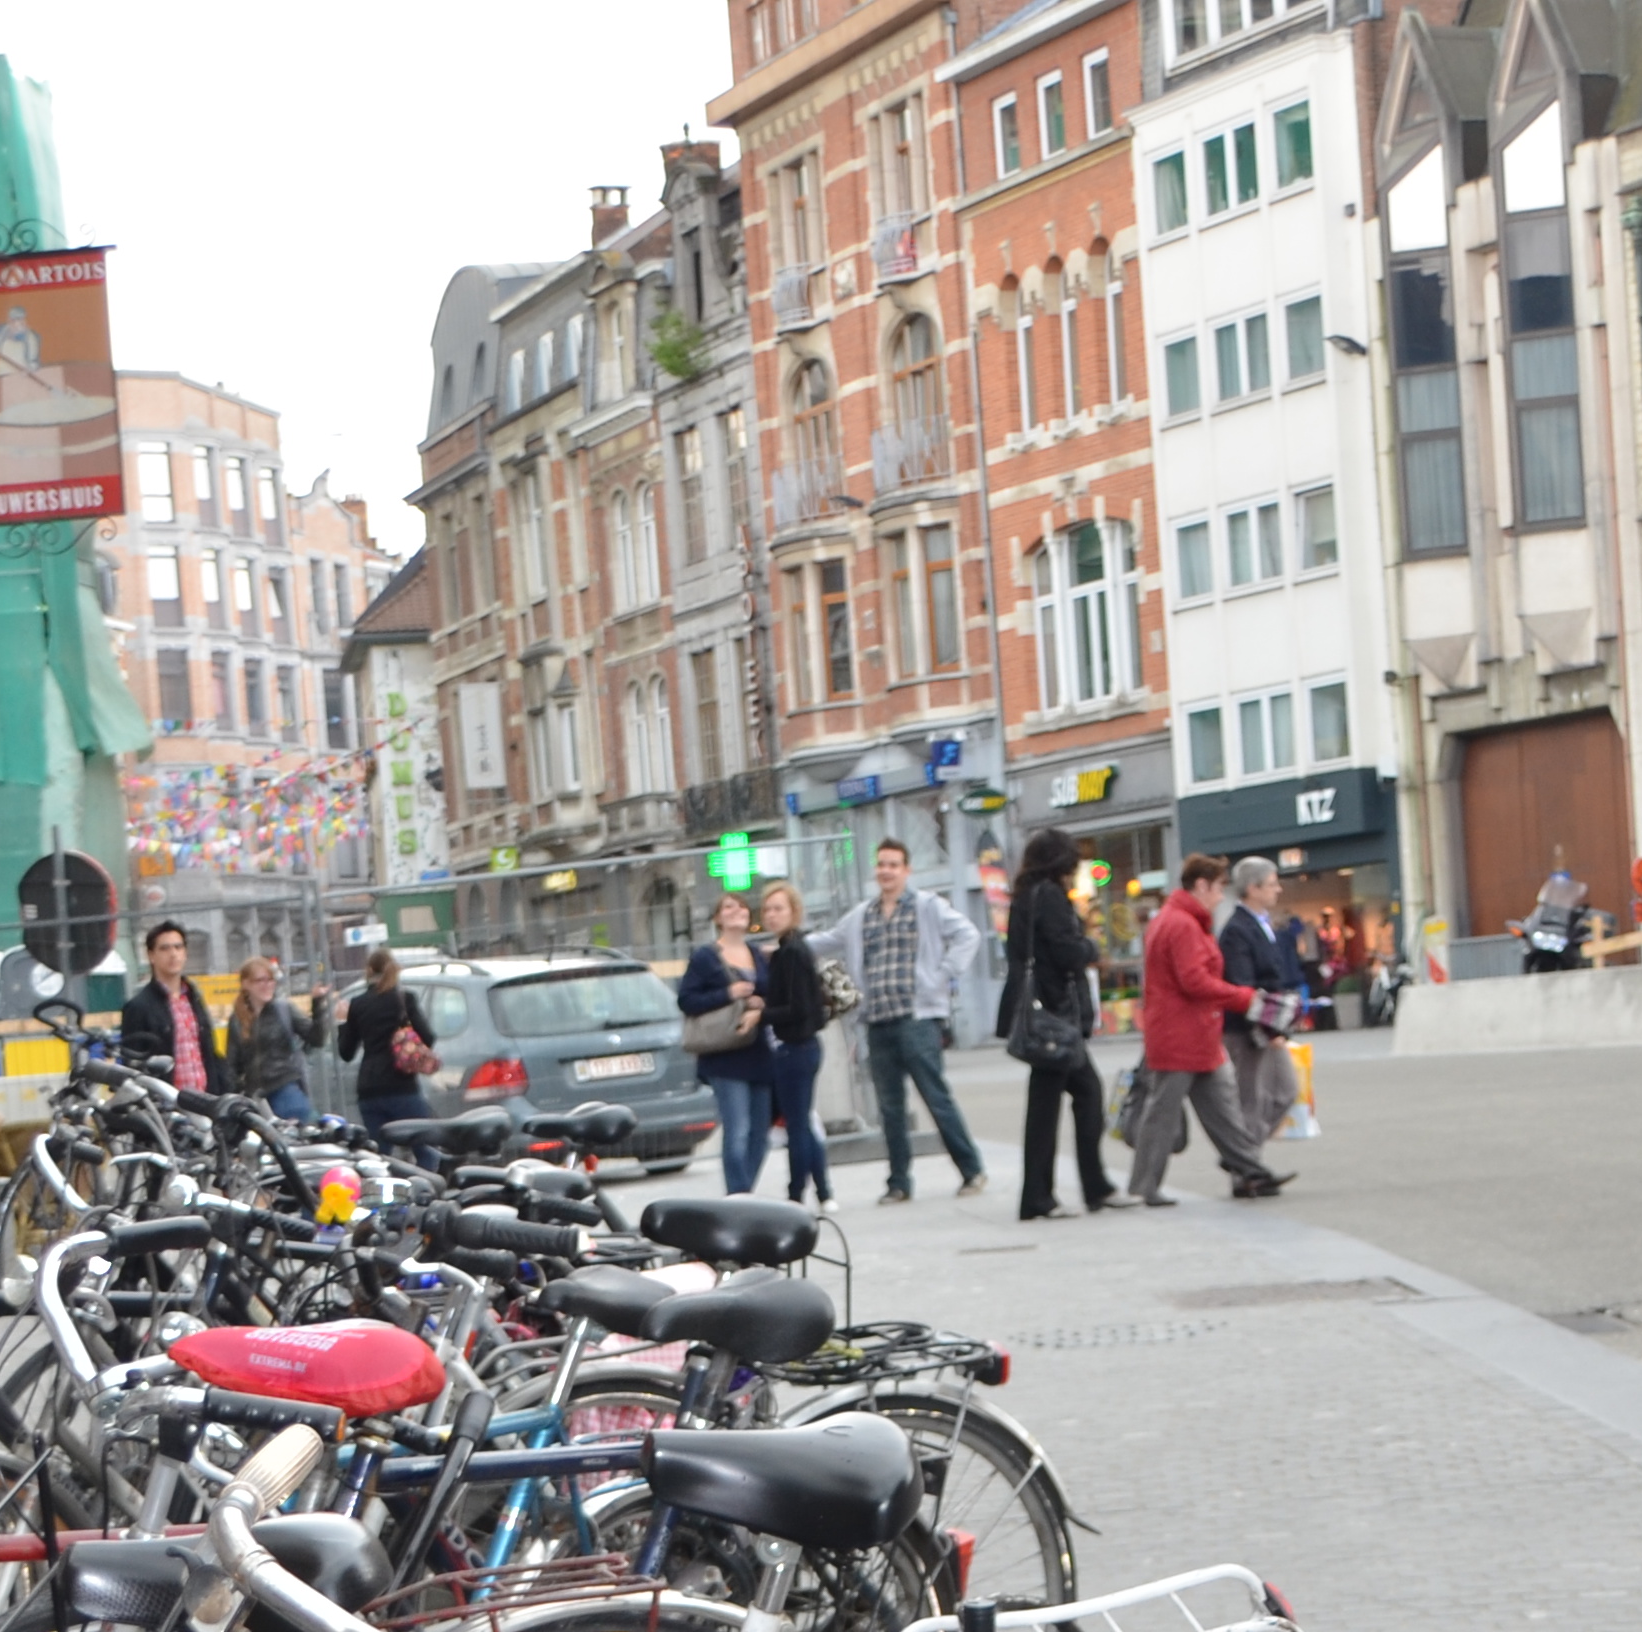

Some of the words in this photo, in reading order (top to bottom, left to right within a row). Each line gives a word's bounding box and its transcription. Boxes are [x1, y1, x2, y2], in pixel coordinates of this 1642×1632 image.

[24, 261, 105, 284] ARTOIS
[387, 691, 418, 854] DOMUS
[1048, 766, 1114, 809] SUBWAY
